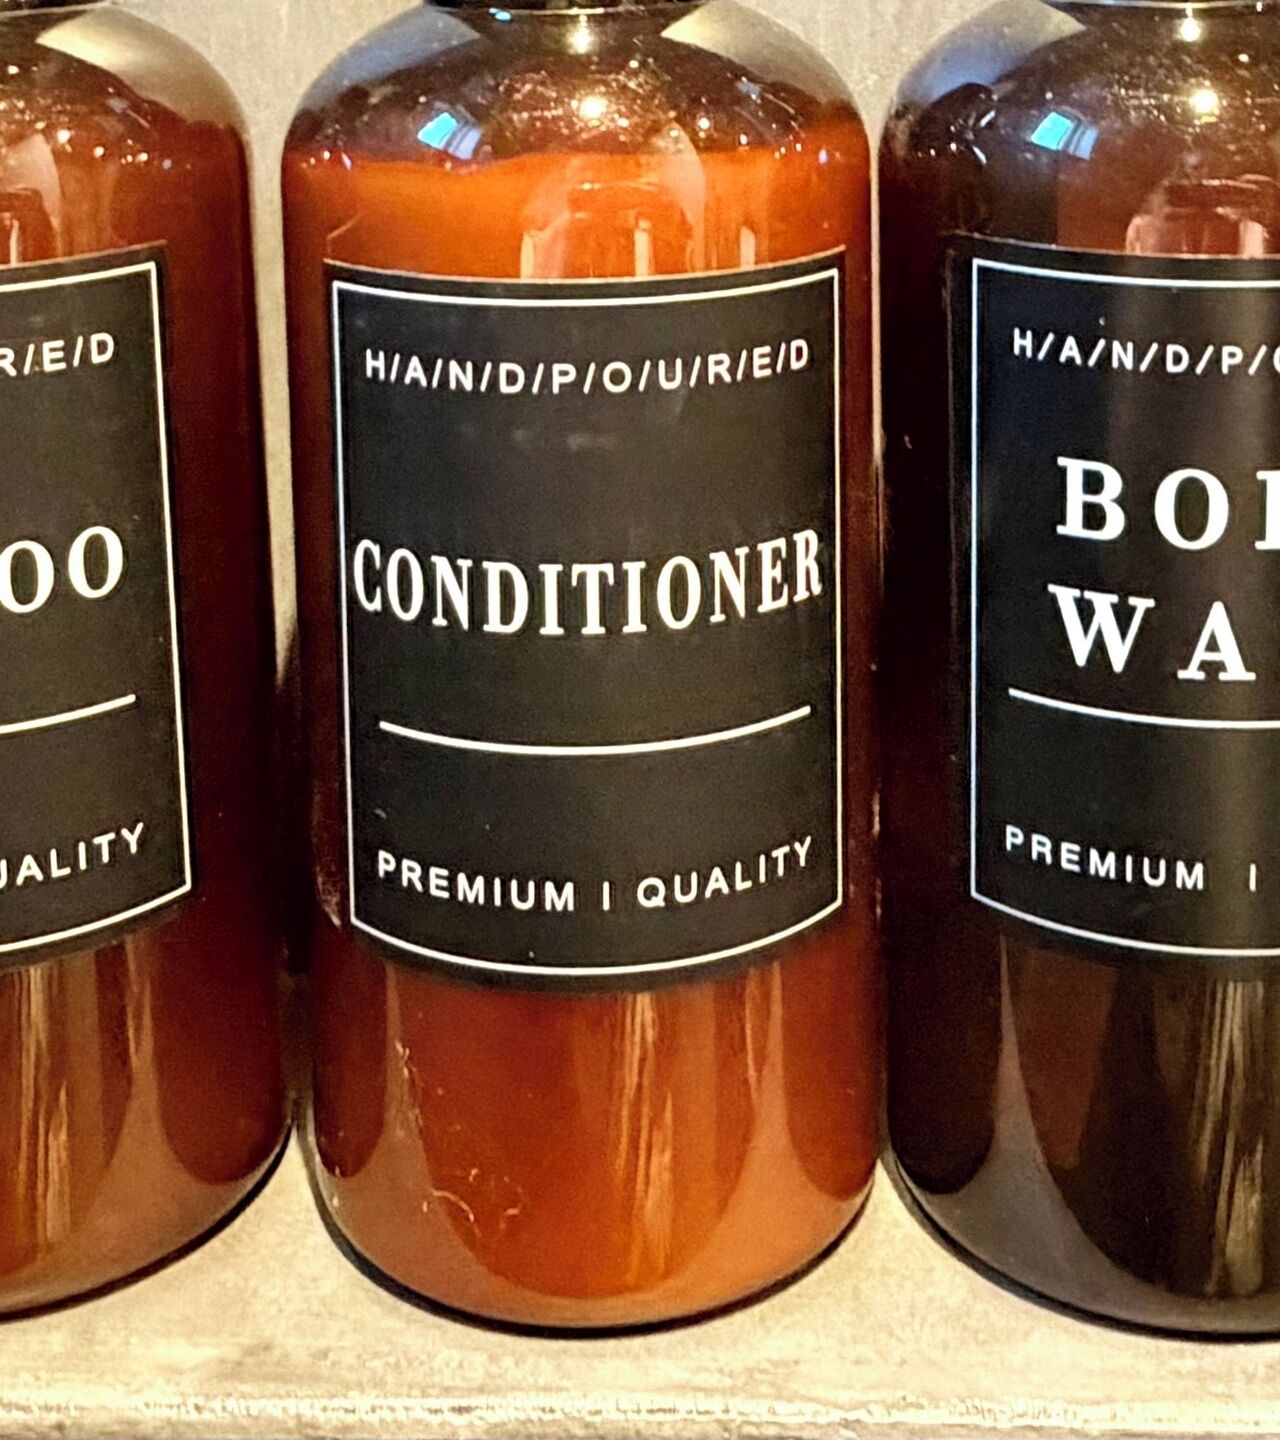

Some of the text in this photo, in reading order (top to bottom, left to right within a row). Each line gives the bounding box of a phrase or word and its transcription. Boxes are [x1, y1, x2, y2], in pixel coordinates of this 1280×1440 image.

[353, 529, 822, 635] CONDITIONER
[377, 849, 575, 912] PREMIUM
[636, 835, 814, 909] QUALITY
[1005, 824, 1204, 891] PREMIUM
